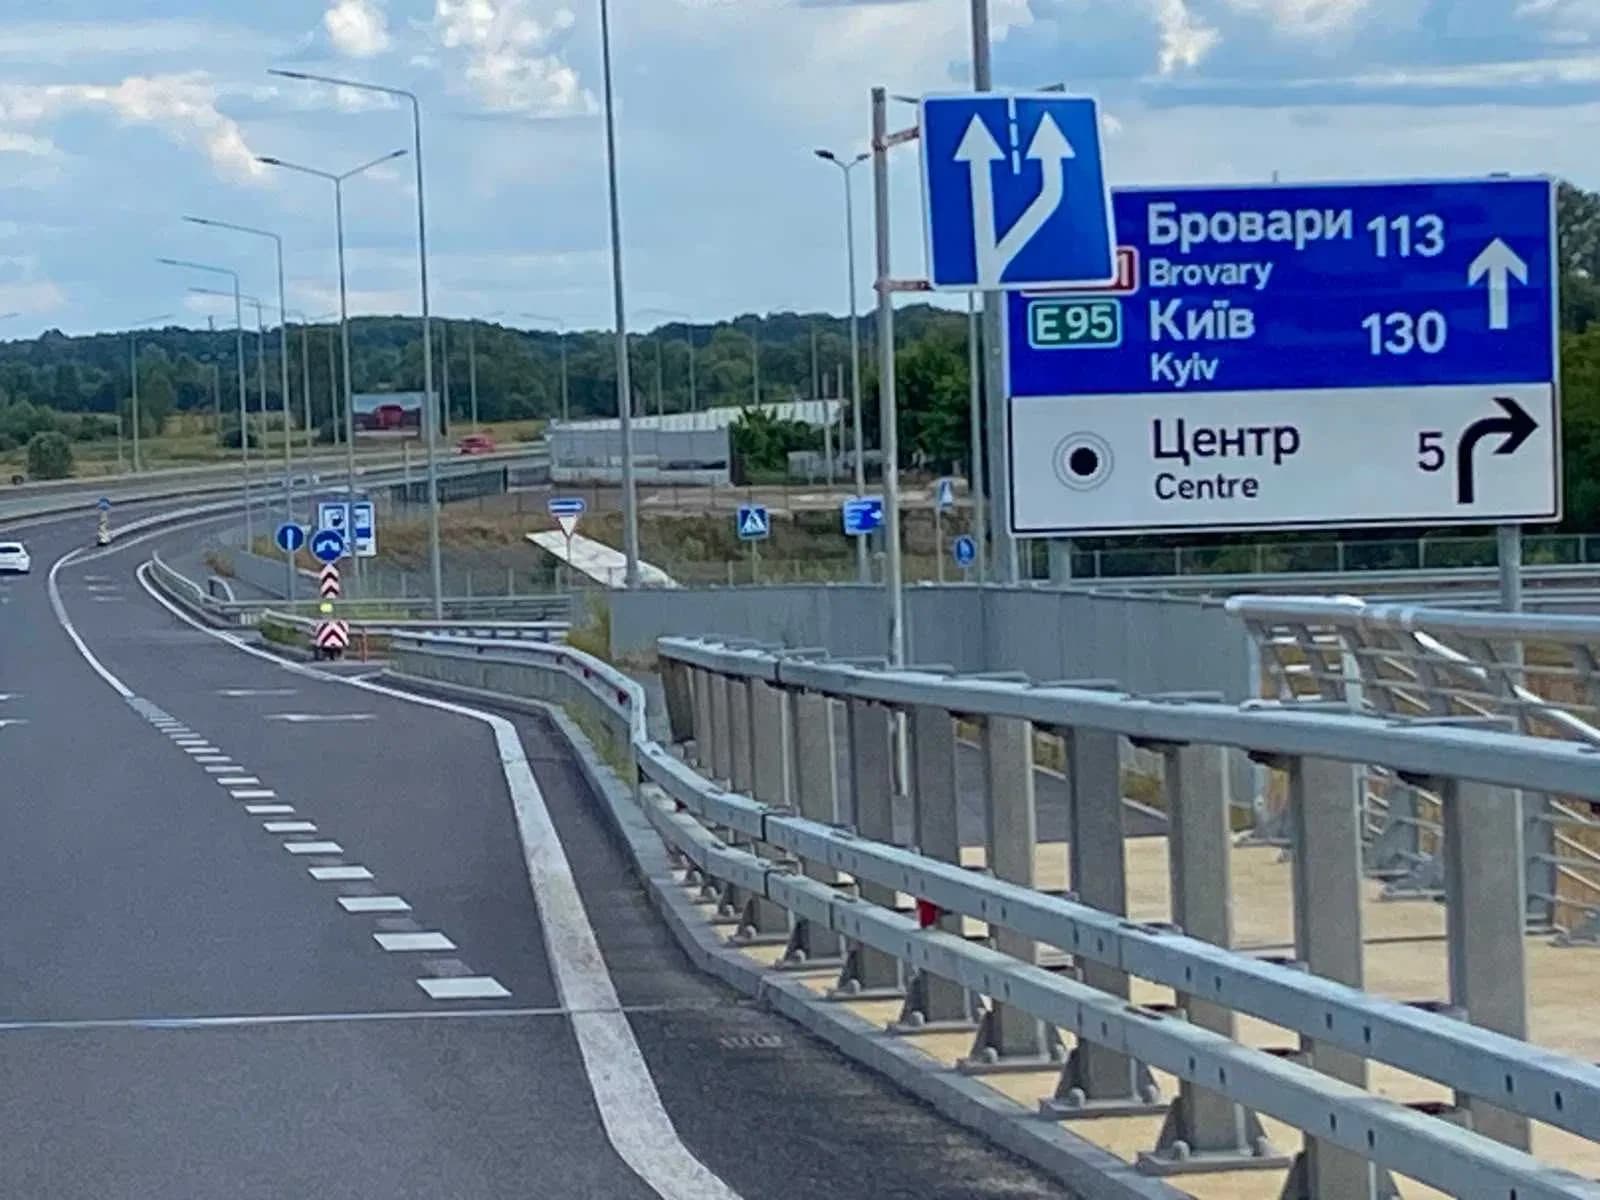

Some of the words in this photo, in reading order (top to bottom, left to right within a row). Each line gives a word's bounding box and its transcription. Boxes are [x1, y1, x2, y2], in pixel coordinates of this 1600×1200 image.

[1148, 202, 1353, 254] Бровари
[1367, 214, 1445, 258] 113
[1149, 257, 1274, 291] Brovary
[1149, 298, 1256, 342] Київ
[1361, 311, 1447, 355] 130
[1151, 351, 1219, 388] Kyiv
[1153, 417, 1301, 467] Центр
[1417, 431, 1446, 472] 5
[1154, 471, 1260, 501] Centre
